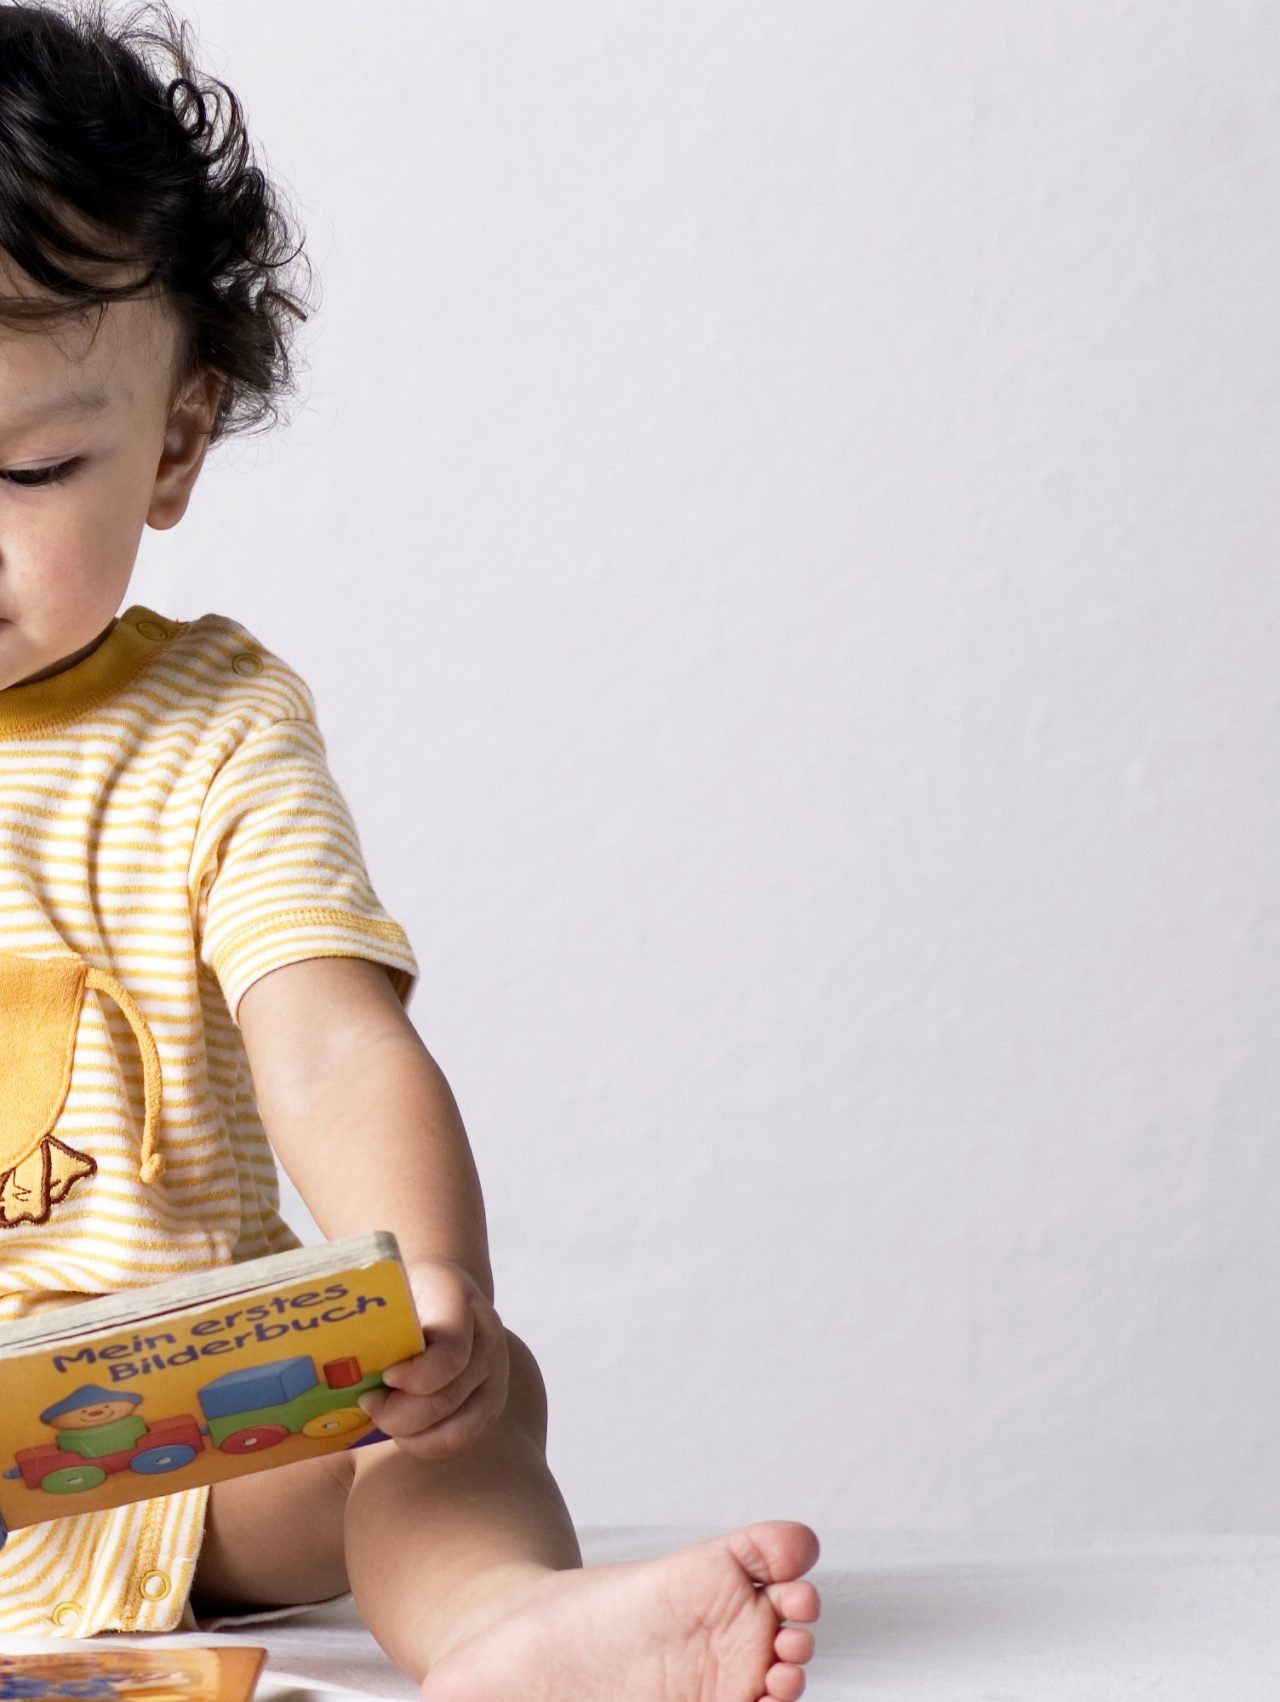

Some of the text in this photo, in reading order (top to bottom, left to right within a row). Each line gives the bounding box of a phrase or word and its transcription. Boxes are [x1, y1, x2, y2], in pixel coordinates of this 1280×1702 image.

[52, 1283, 349, 1374] Mein erstes
[108, 1294, 387, 1383] Bilderbuch
